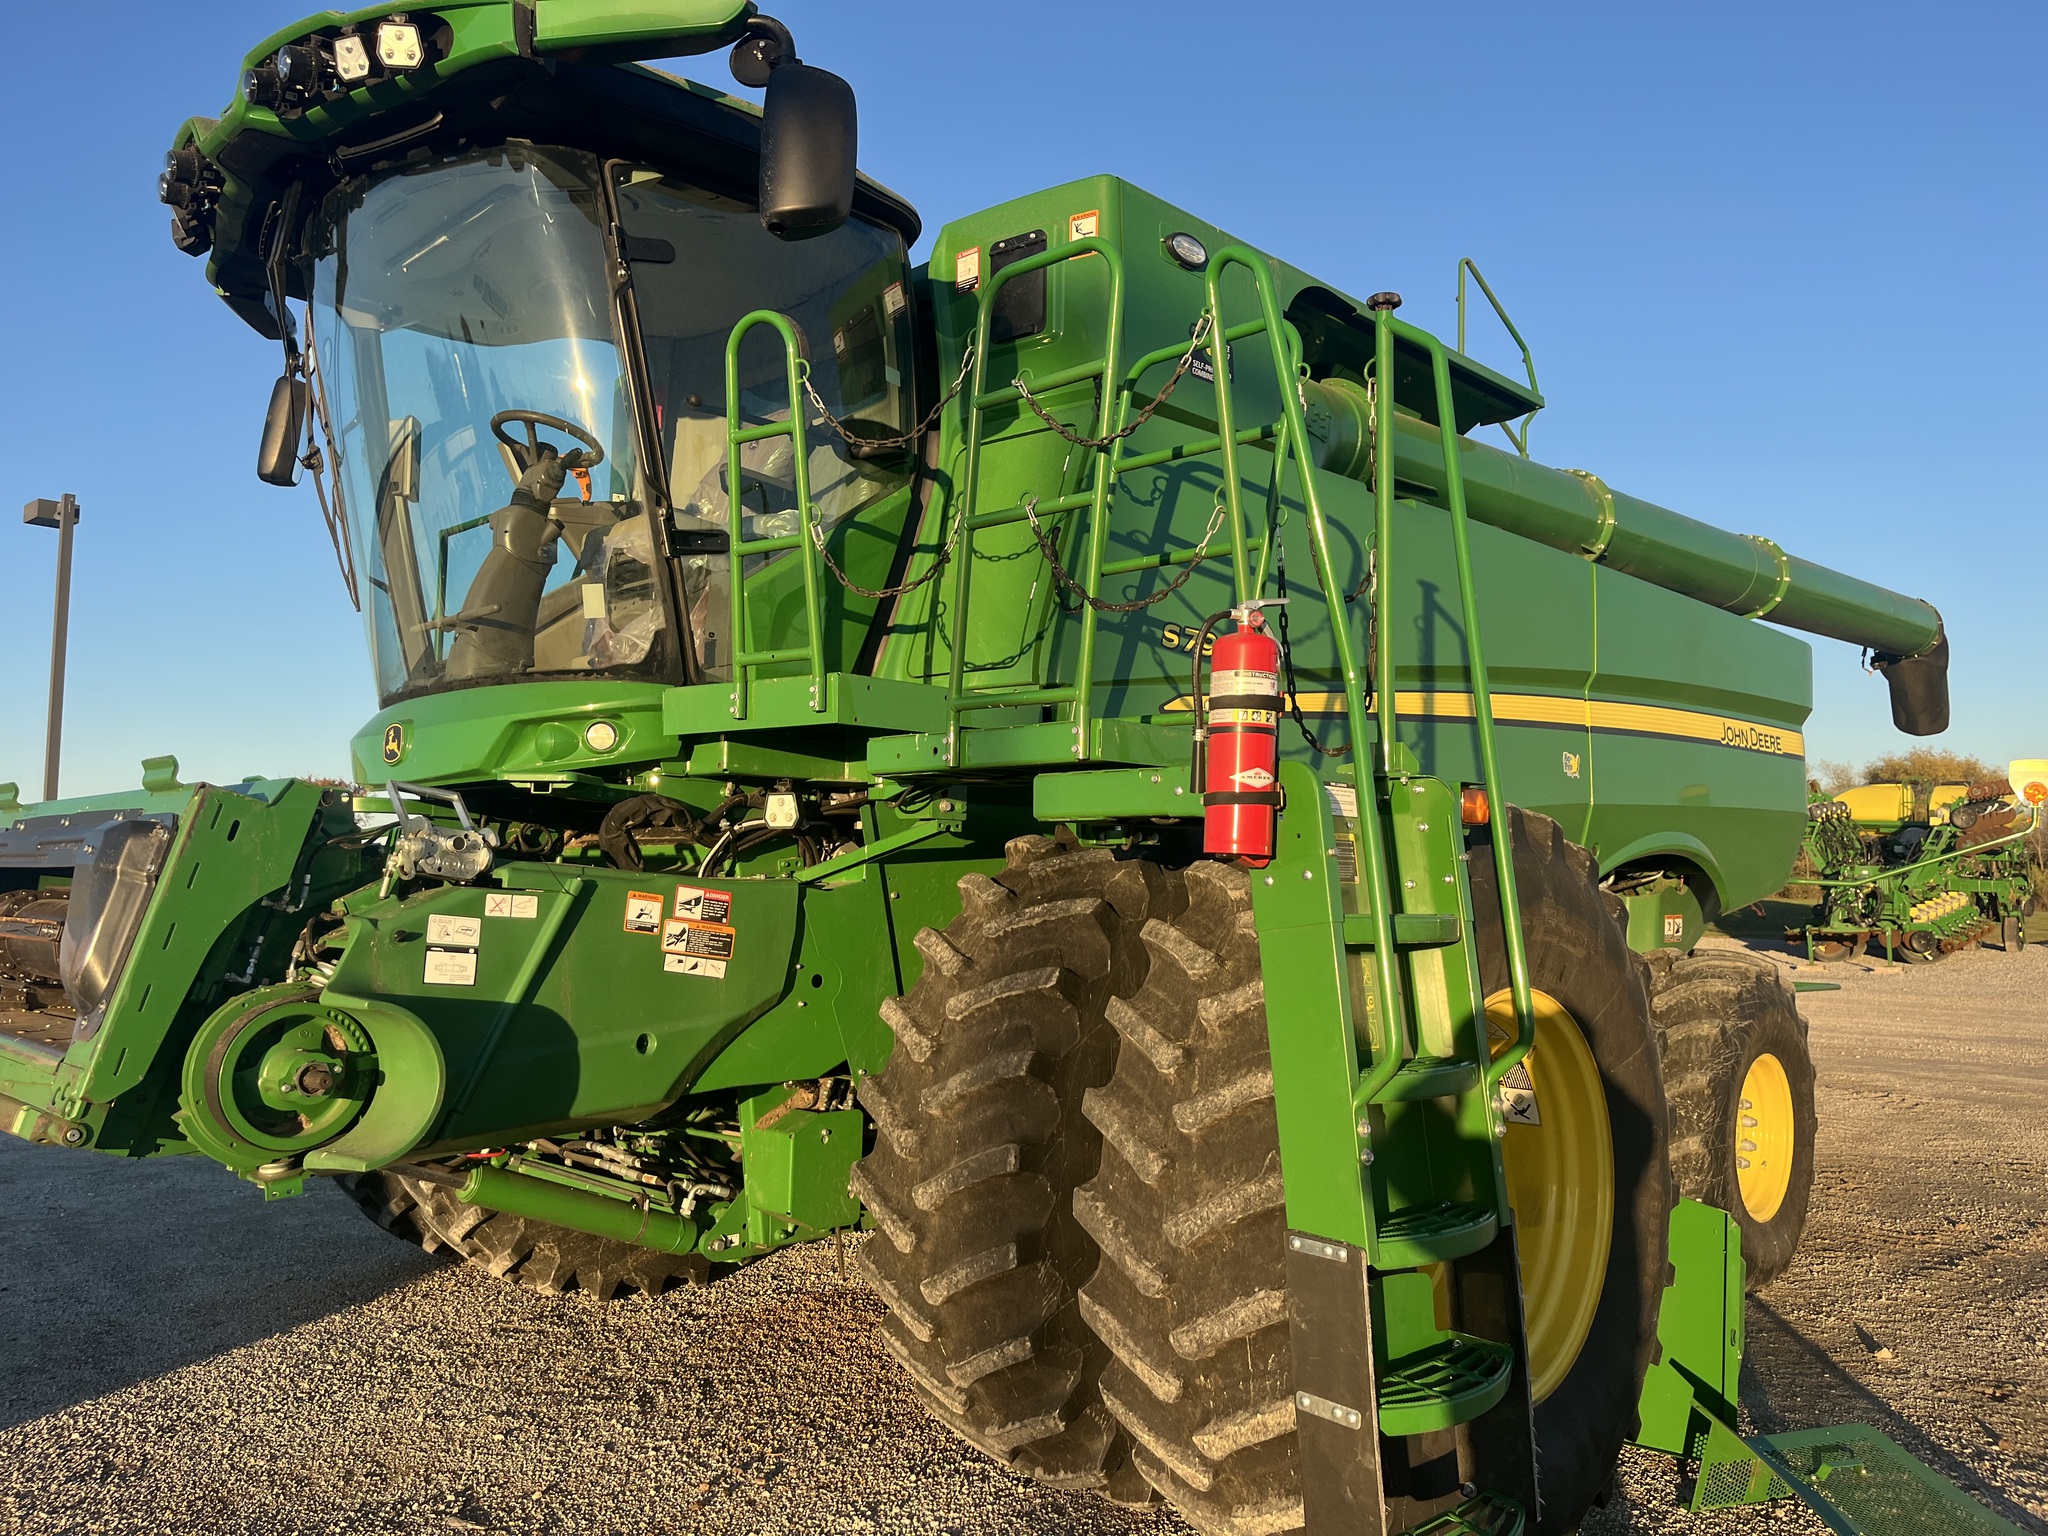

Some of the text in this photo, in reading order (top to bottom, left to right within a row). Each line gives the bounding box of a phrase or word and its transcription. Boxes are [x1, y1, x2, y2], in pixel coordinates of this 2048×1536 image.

[1162, 622, 1218, 656] S79
[1720, 721, 1783, 753] JOHN DEERE
[637, 893, 659, 901] WARNING
[709, 892, 730, 900] DANGER
[701, 924, 724, 932] WARNING
